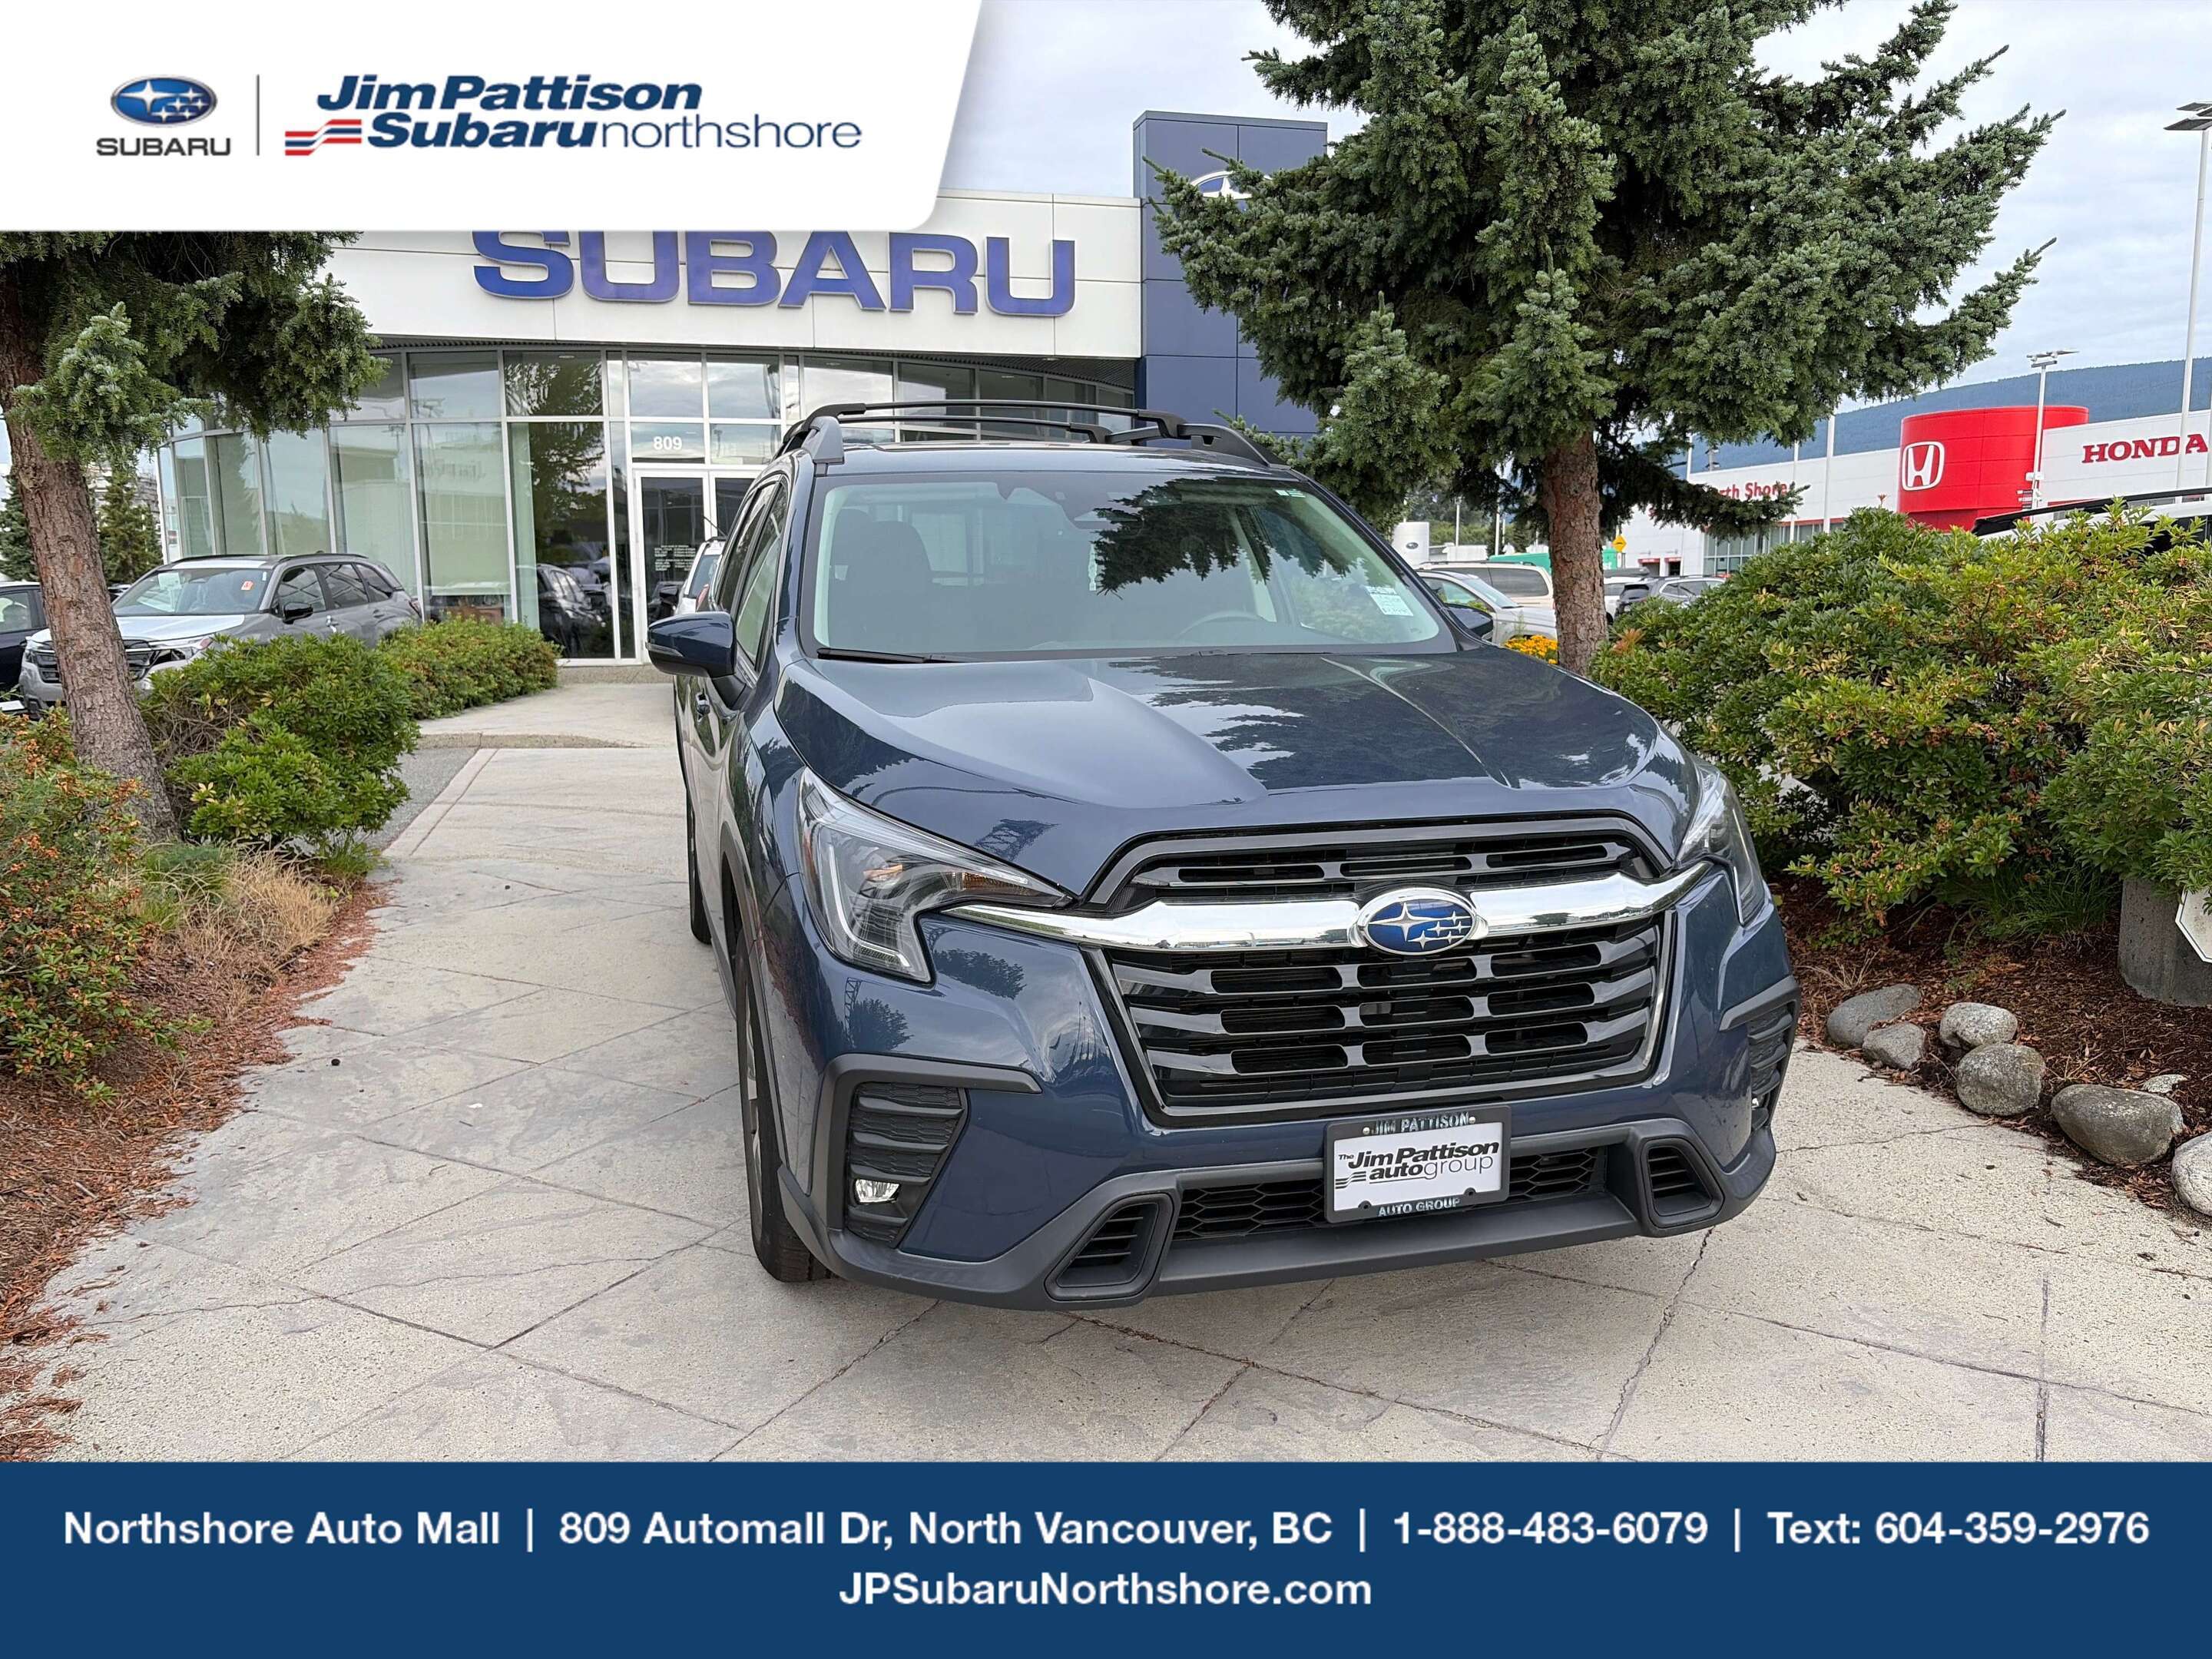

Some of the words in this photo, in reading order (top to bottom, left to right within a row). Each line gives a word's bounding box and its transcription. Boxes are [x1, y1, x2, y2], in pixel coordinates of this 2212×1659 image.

[472, 230, 1076, 316] SUBARU
[654, 435, 683, 450] 809
[2081, 433, 2209, 464] HONDA
[1371, 1119, 1396, 1135] JIM
[1400, 1111, 1469, 1133] PATTISON
[1348, 1151, 1396, 1169] Jim
[1395, 1141, 1499, 1164] Pattison
[1378, 1203, 1412, 1217] AUTO
[1416, 1197, 1461, 1212] GROUP
